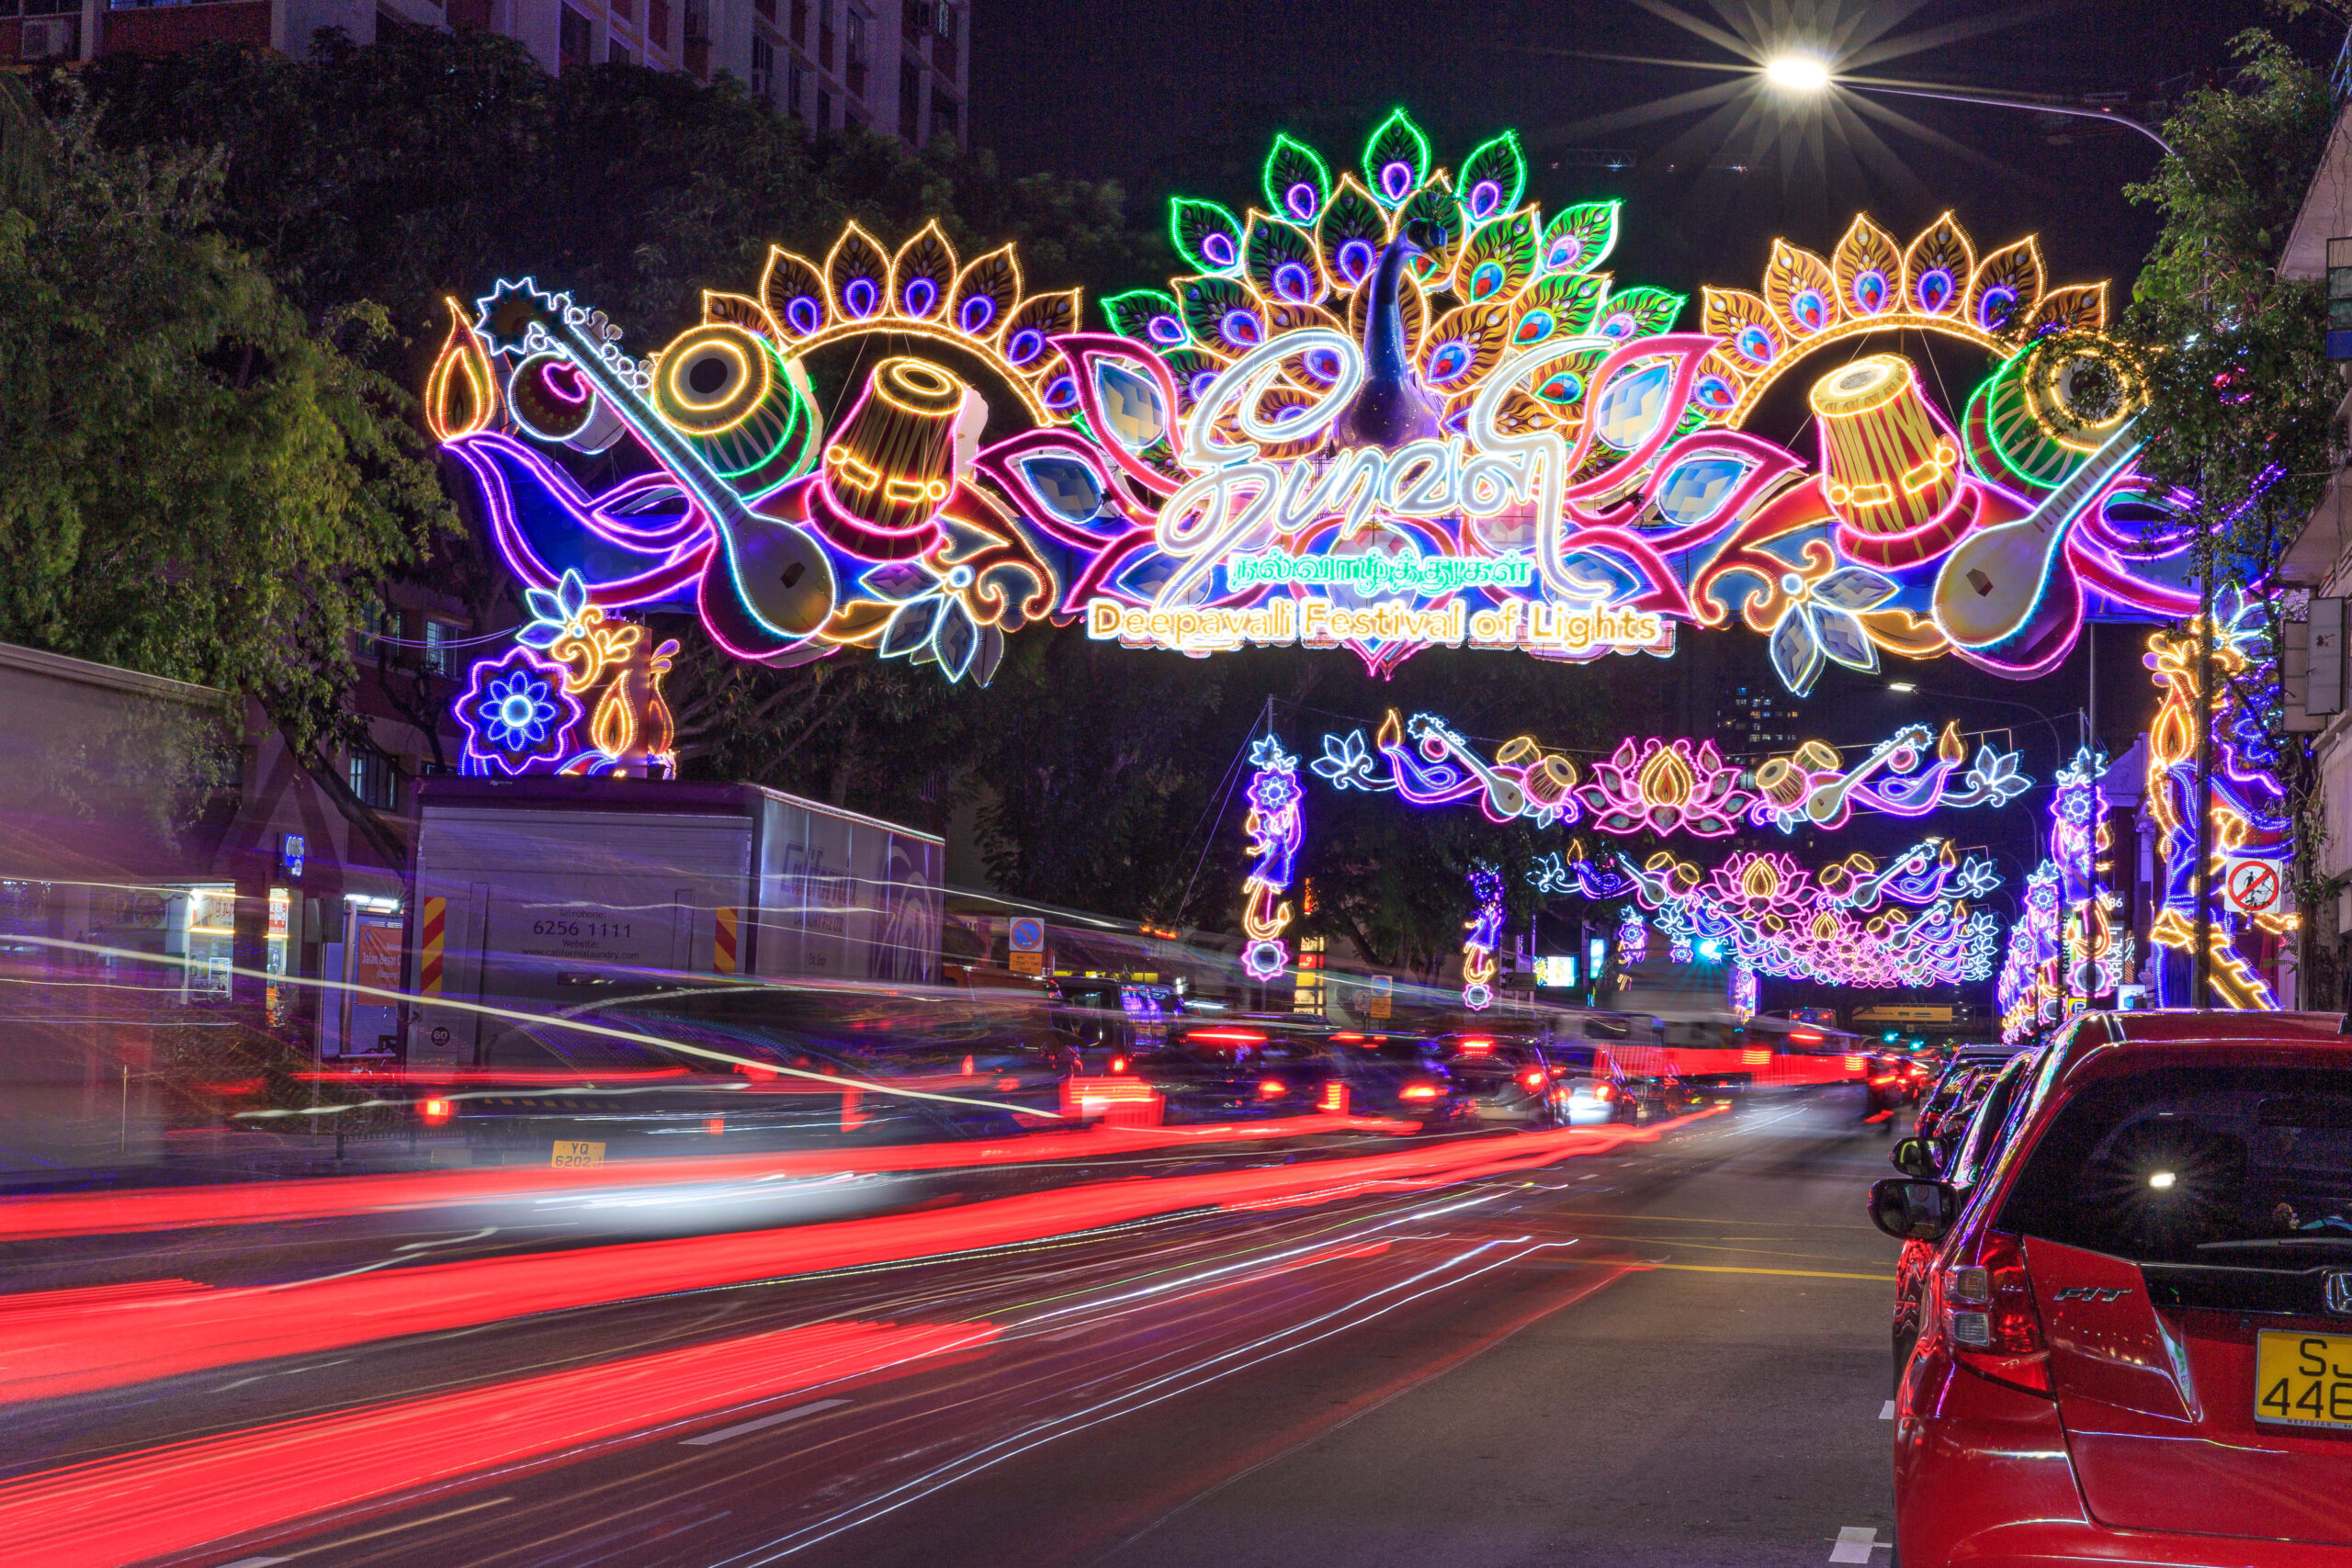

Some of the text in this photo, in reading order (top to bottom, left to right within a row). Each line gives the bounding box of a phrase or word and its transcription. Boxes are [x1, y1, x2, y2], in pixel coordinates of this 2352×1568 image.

[1091, 600, 1660, 649] Deepavali Festival of Lights
[534, 920, 631, 938] 6256 1111
[561, 940, 600, 949] Website:
[521, 947, 640, 961] www.californialaundry.com
[434, 1030, 447, 1040] 60
[571, 1143, 589, 1155] YQ
[2052, 1287, 2132, 1302] FIT
